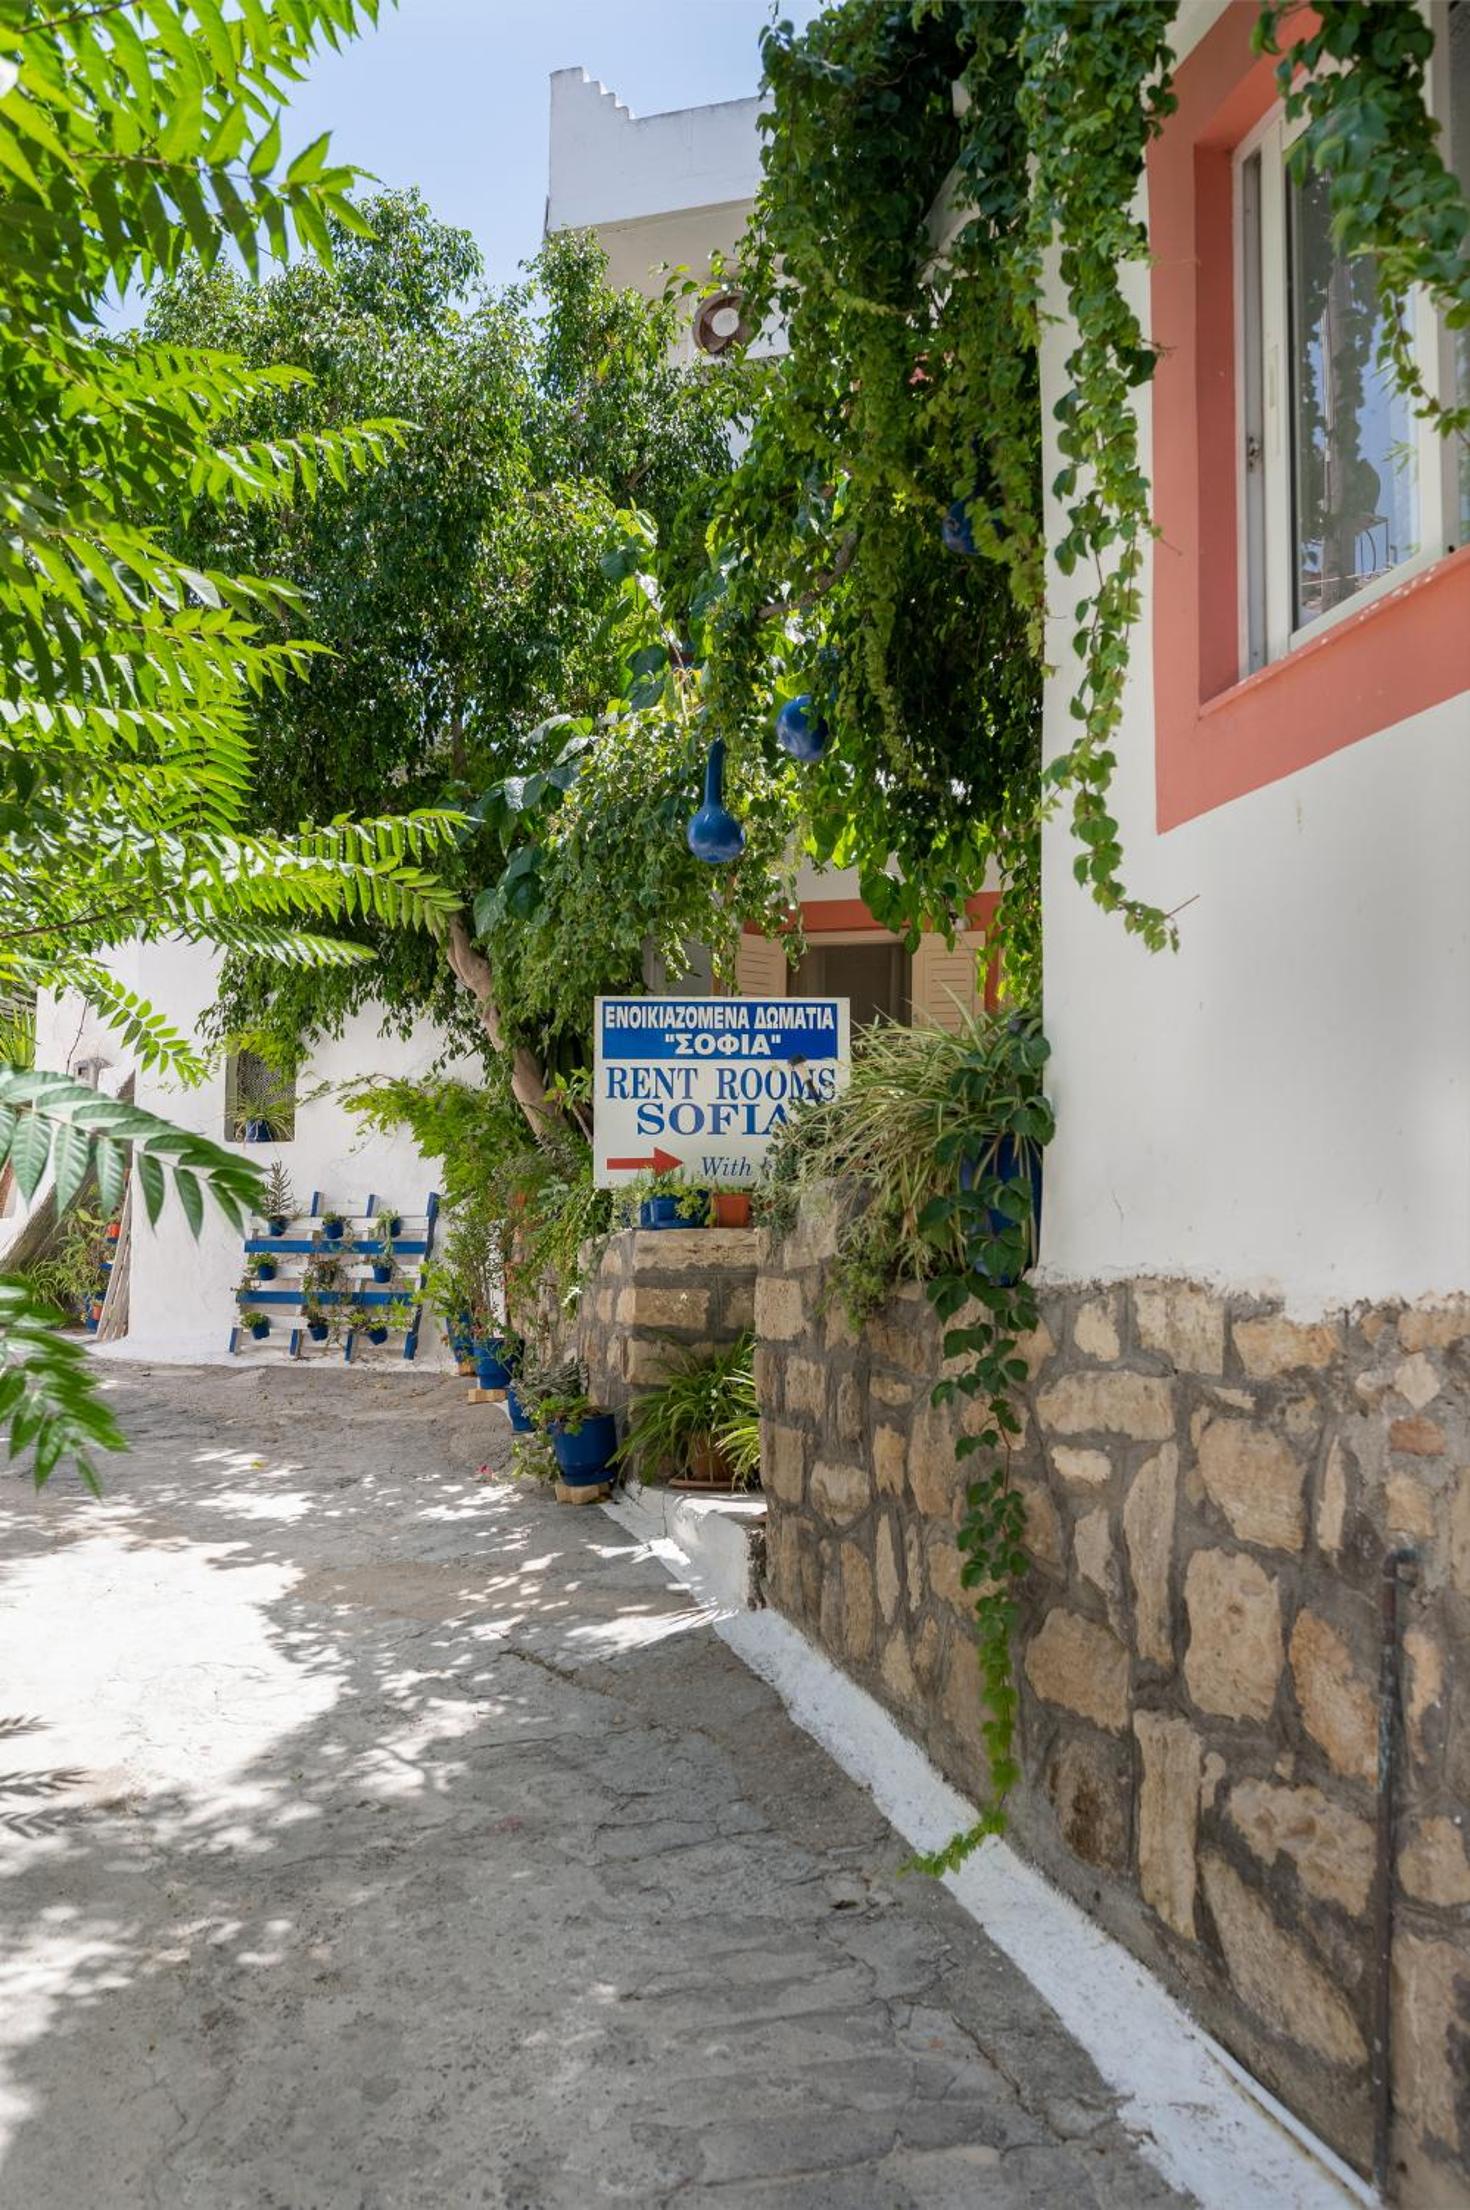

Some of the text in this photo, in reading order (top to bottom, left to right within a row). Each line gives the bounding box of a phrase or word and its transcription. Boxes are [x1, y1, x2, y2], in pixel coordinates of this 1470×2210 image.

[604, 1005, 834, 1030] ΕΝΟΙΚΙΑΖΟΜΕΝΑ ΔΩΜΑΤΙΑ
[664, 1032, 782, 1056] "ΣΟΦΙΑ"
[606, 1066, 836, 1101] RENT ROOMS
[702, 1155, 753, 1177] With
